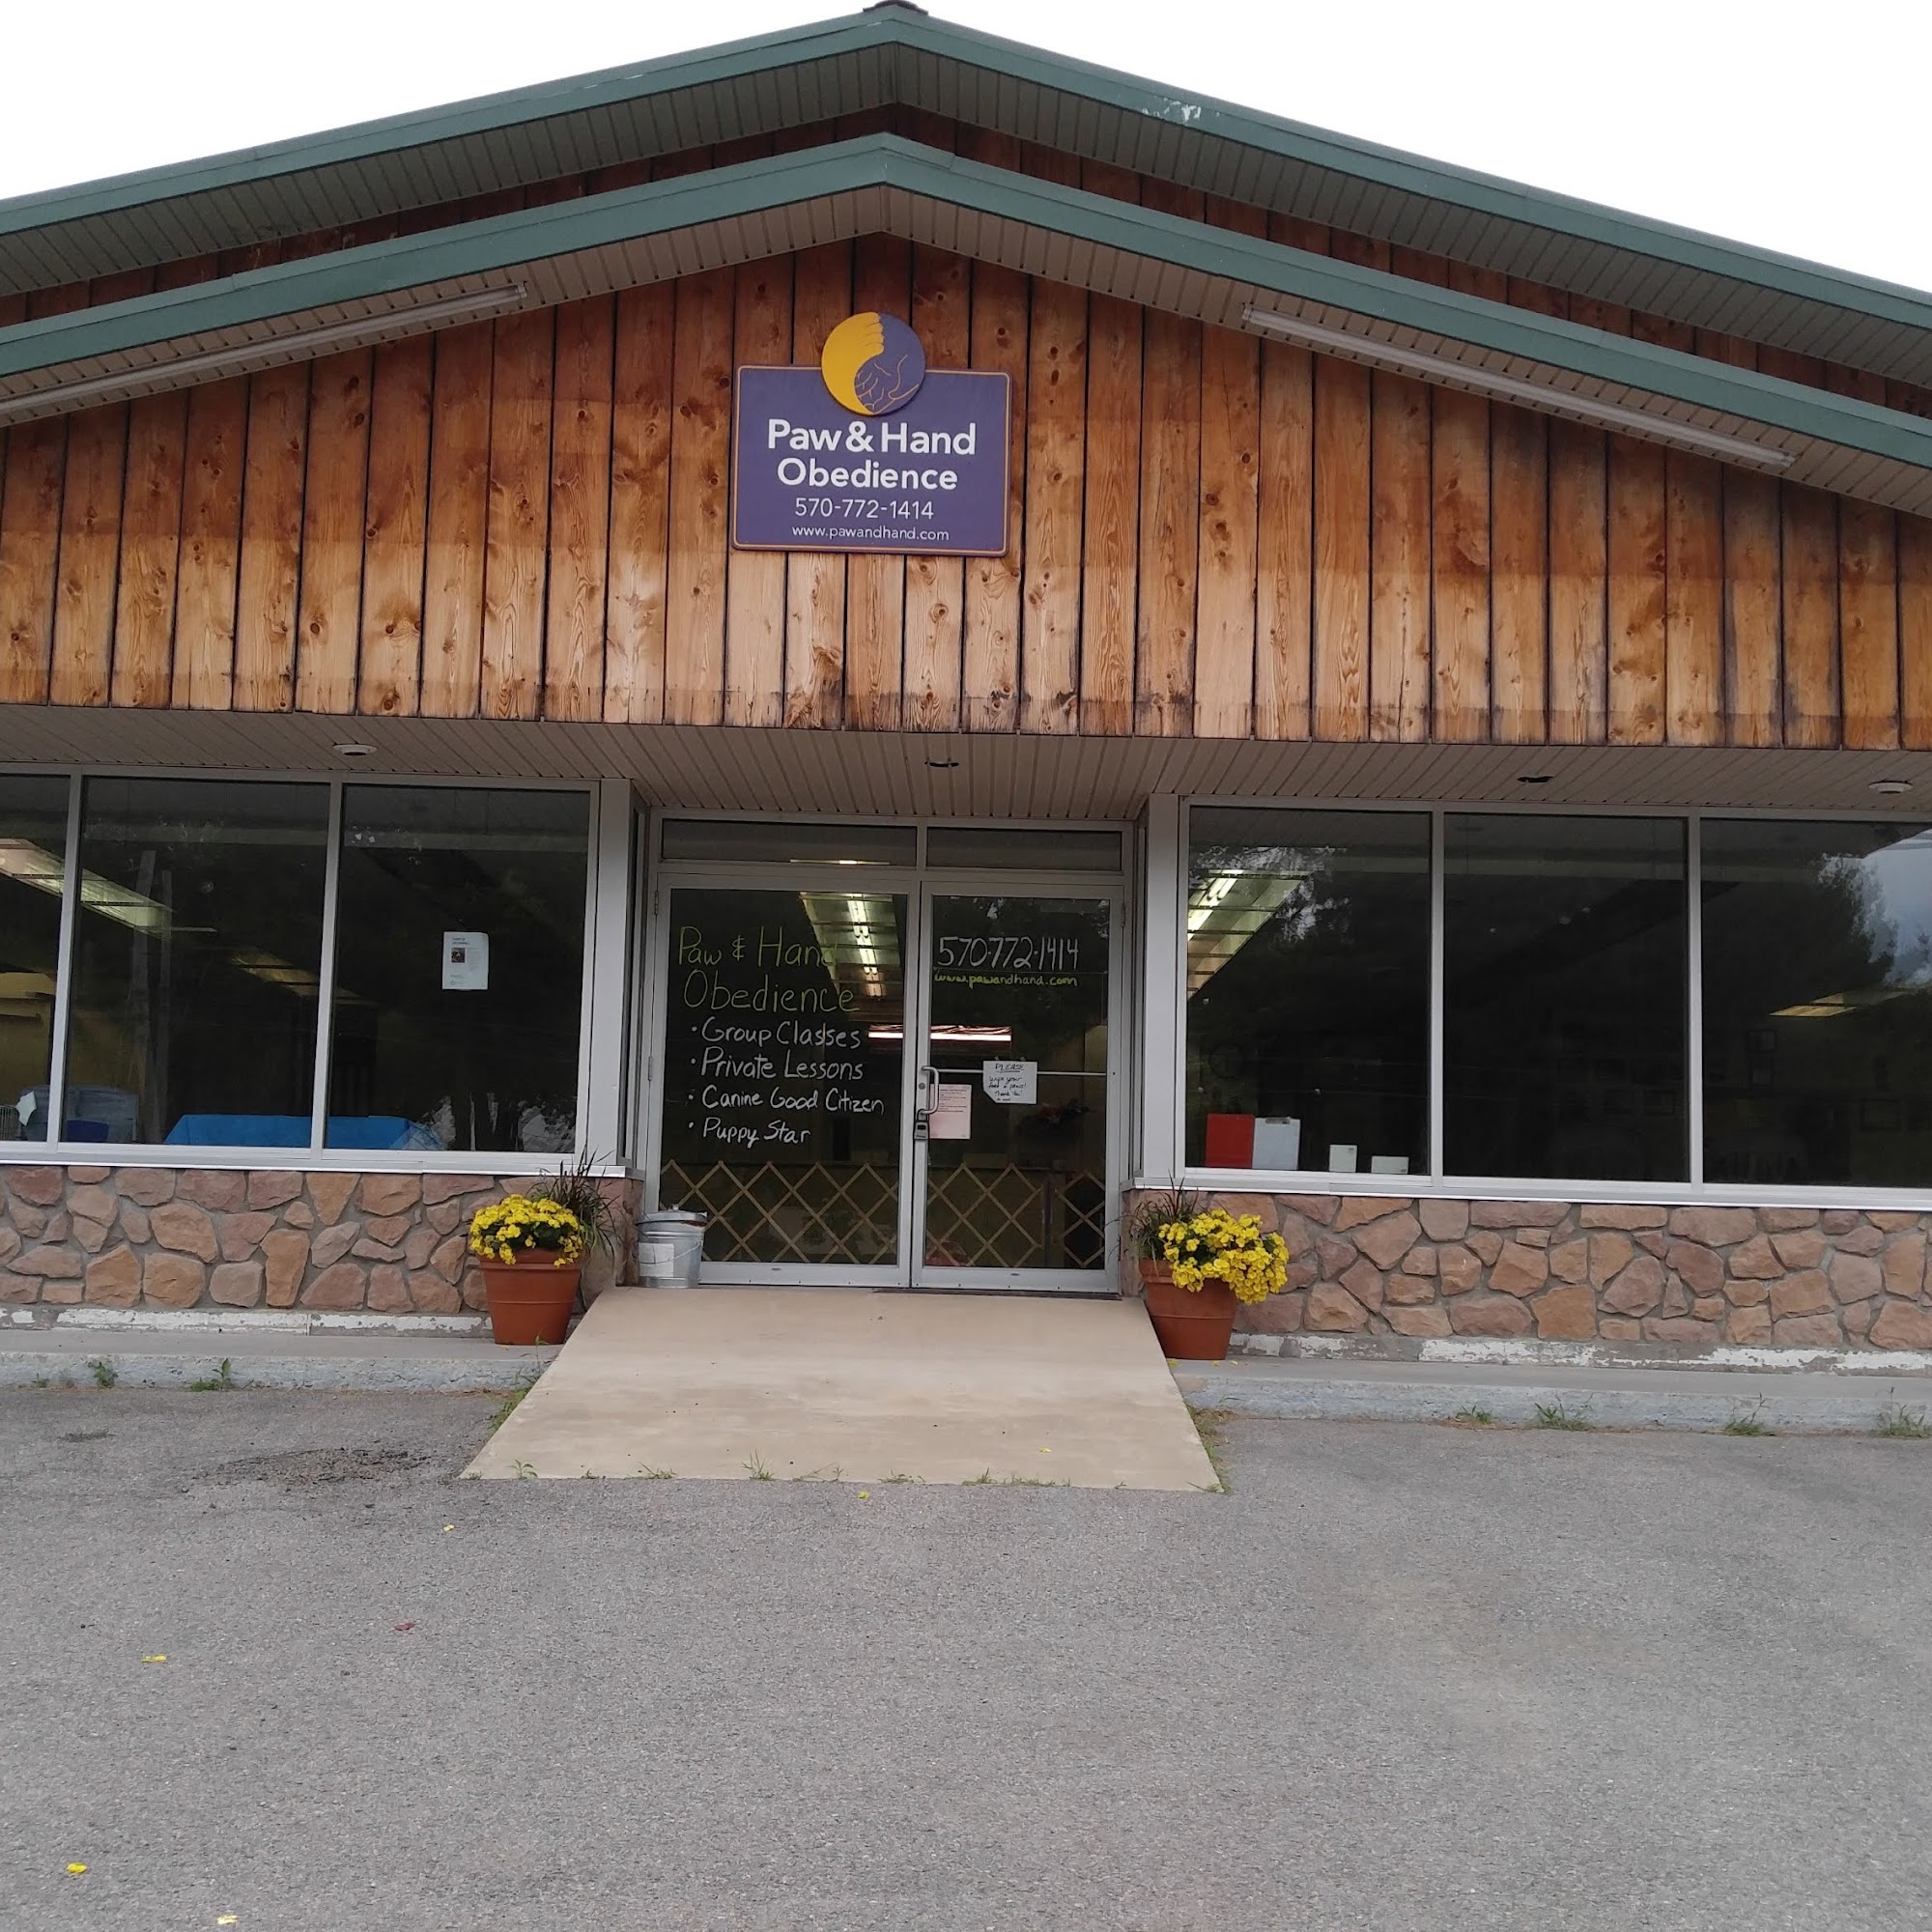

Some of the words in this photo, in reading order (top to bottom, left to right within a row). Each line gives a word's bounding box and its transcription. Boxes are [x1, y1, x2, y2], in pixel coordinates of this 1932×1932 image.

[768, 418, 842, 451] Paw
[845, 421, 874, 453] &
[881, 422, 976, 455] Hand
[777, 457, 958, 490] Obedience
[795, 497, 935, 520] 570-772-1414
[792, 525, 950, 541] www.pawandhand.com
[678, 925, 723, 966] Paw
[758, 925, 838, 967] Hand
[683, 968, 861, 1012] Obedience
[934, 971, 1078, 989] www.pawandhand.com
[701, 1016, 772, 1047] Group
[776, 1020, 861, 1049] Classes
[700, 1046, 777, 1079] Private
[783, 1049, 864, 1080] Lessons
[701, 1084, 764, 1110] Canine
[770, 1087, 818, 1110] Good
[825, 1087, 885, 1116] Citizen
[702, 1117, 760, 1149] Puppy
[763, 1120, 811, 1145] Star
